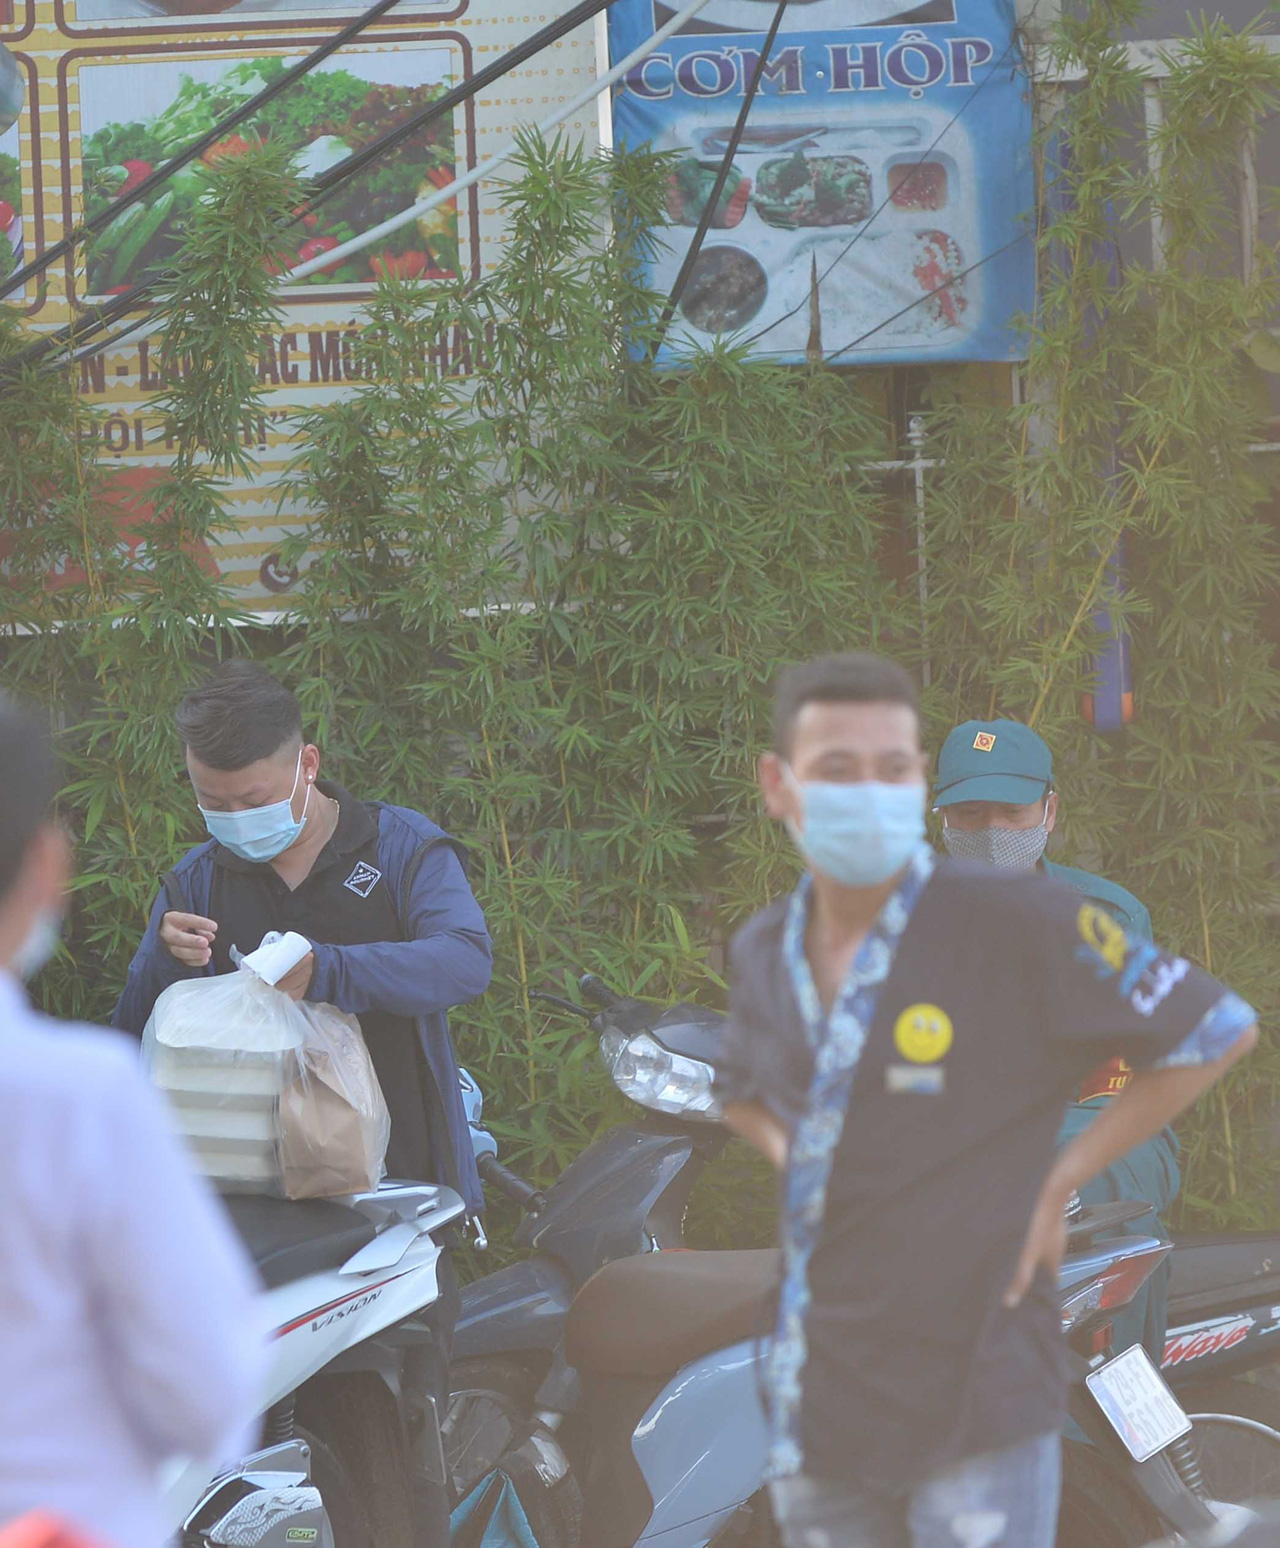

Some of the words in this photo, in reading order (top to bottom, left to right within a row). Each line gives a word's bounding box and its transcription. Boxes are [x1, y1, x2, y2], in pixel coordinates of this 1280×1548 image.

[624, 46, 807, 100] CƠM
[826, 30, 993, 99] HỘP
[311, 1289, 383, 1332] VISION
[1160, 1325, 1252, 1369] Wave
